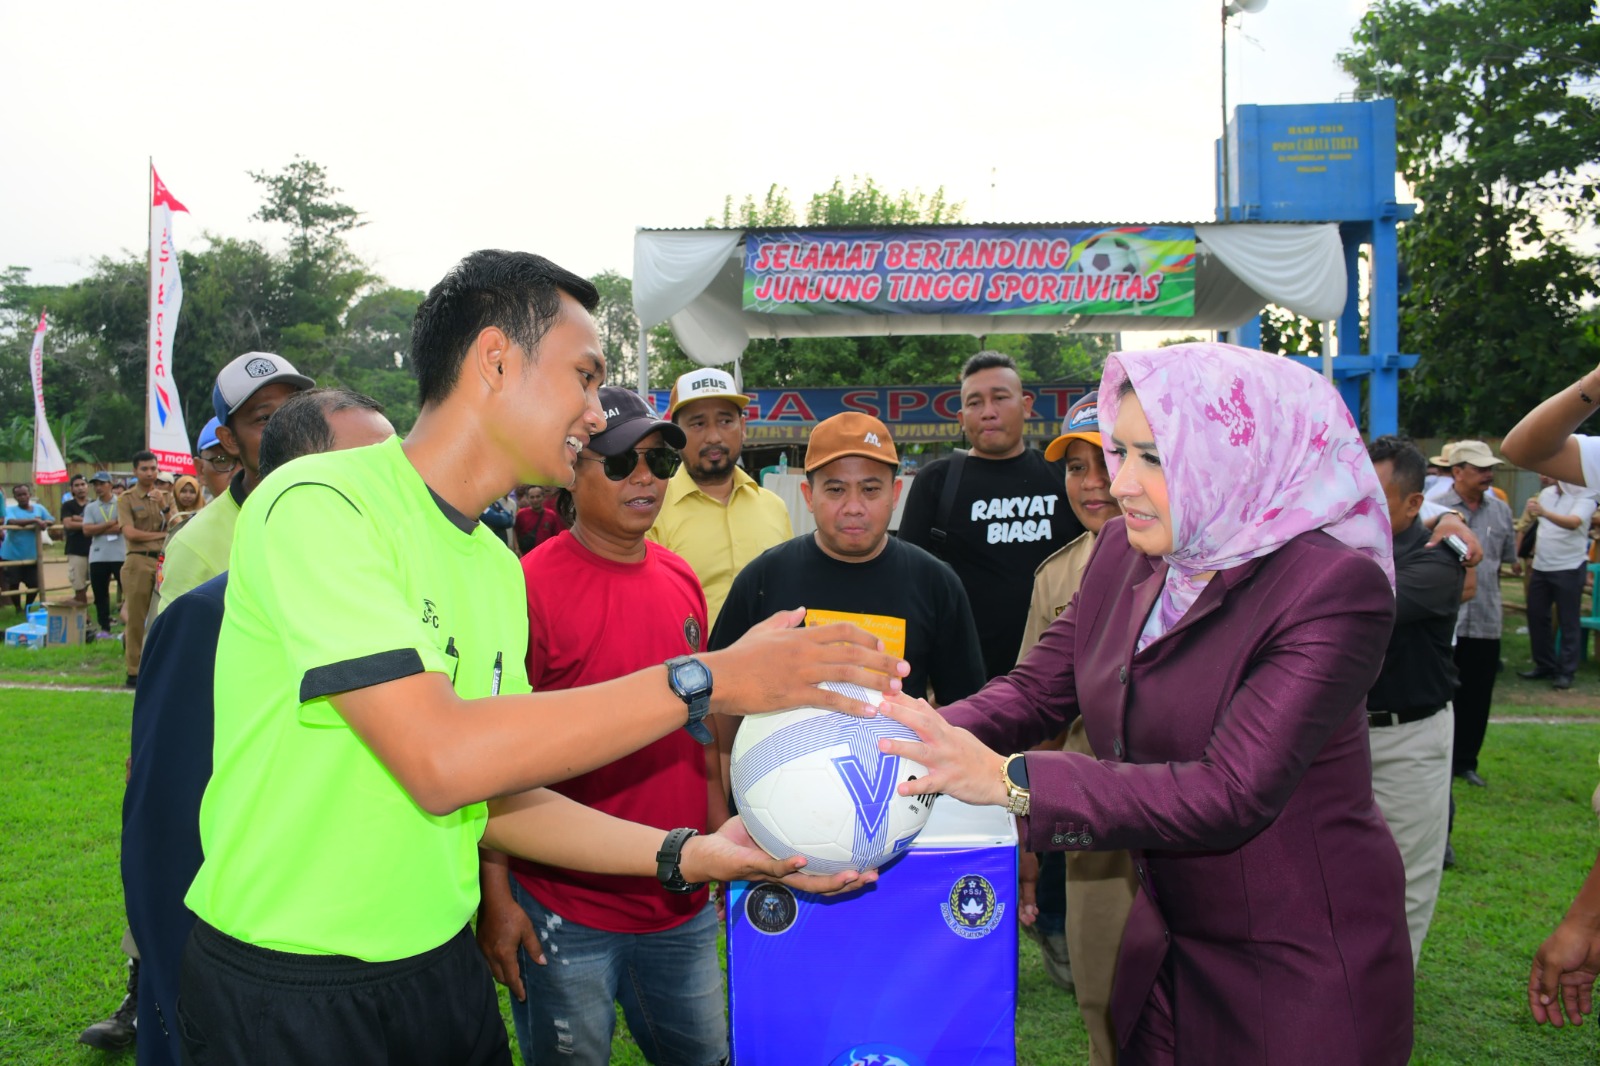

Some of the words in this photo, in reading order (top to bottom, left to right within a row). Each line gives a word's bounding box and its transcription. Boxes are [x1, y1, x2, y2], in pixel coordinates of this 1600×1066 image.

[754, 241, 883, 272] SELAMAT
[885, 238, 1070, 271] BERTANDING
[754, 273, 882, 303] JUNJUNG
[886, 273, 984, 303] TINGGI
[985, 271, 1164, 303] SPORTIVITAS
[691, 378, 728, 391] DEUS
[971, 494, 1059, 521] RAKYAT
[986, 519, 1052, 545] BIASA
[963, 888, 982, 896] PSSI
